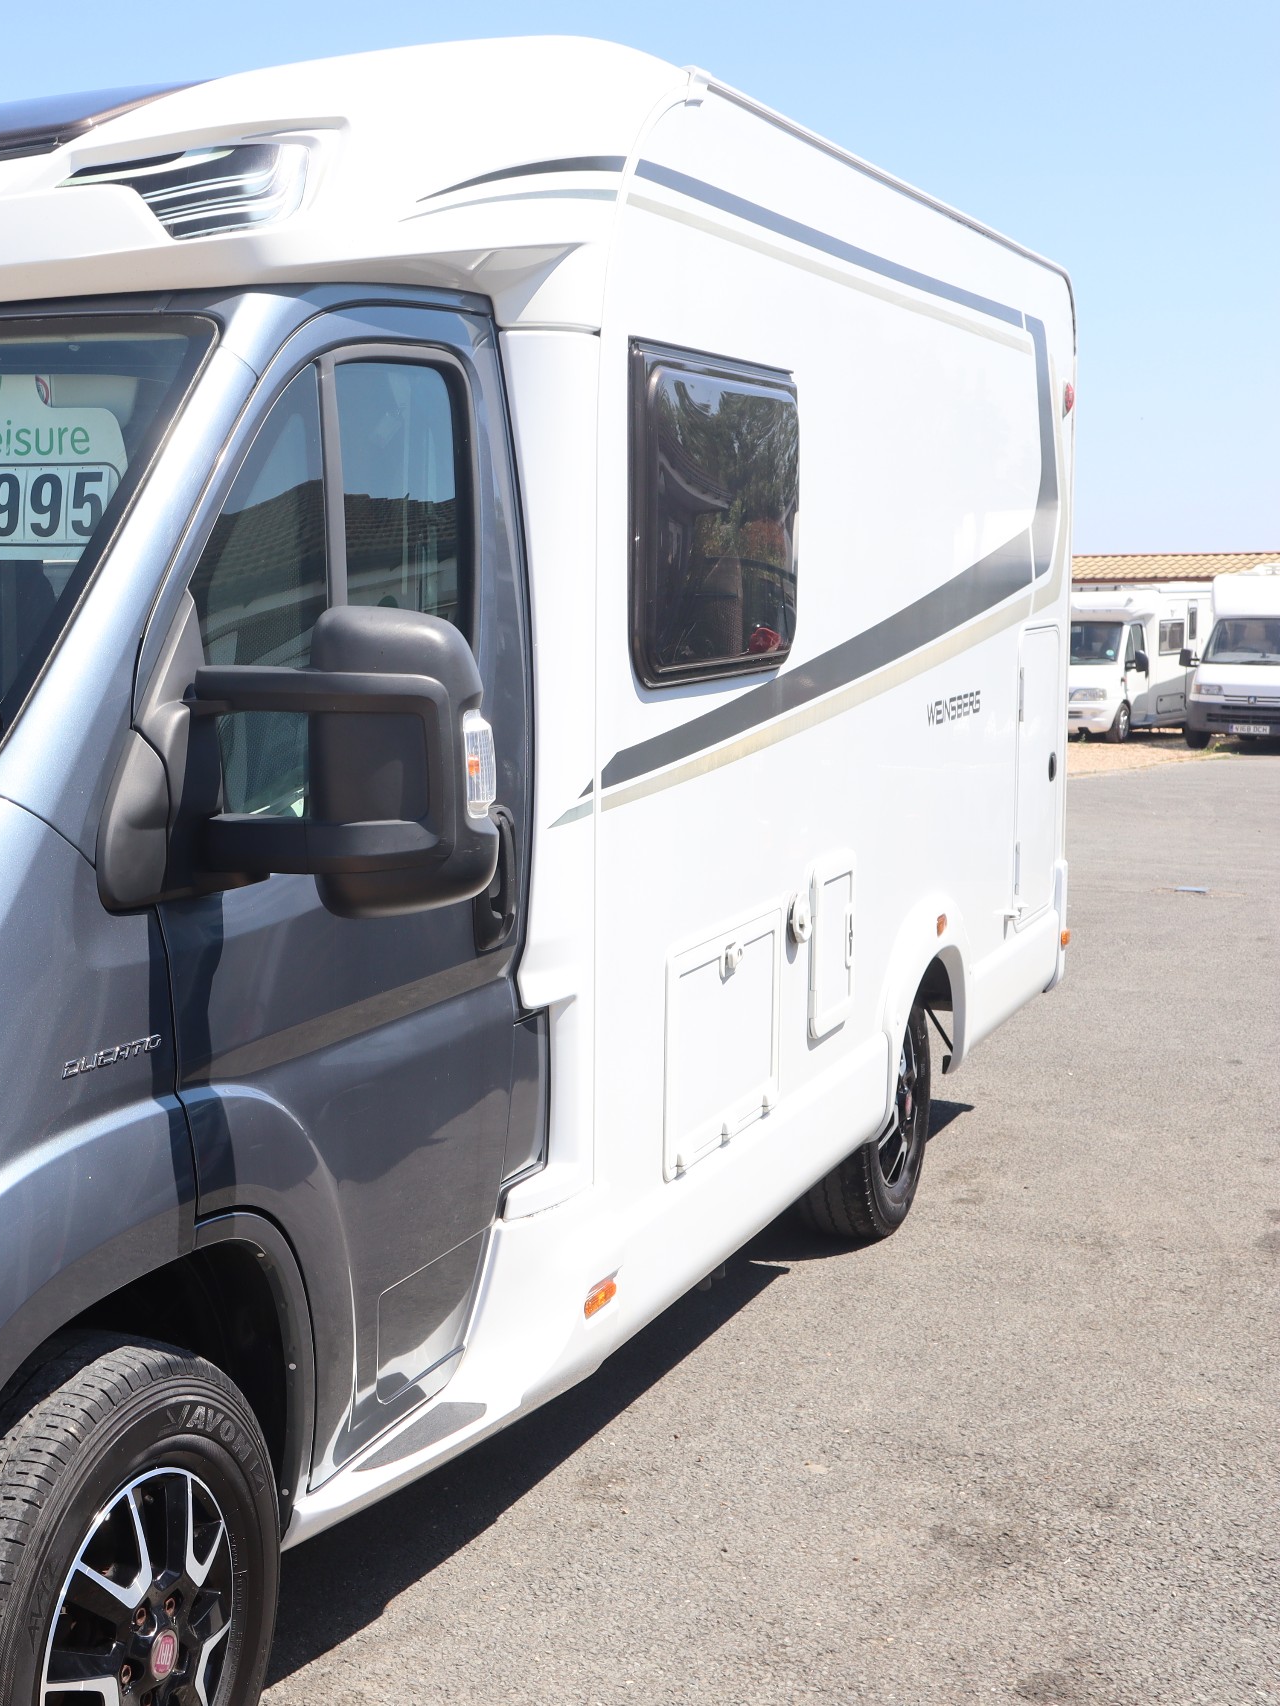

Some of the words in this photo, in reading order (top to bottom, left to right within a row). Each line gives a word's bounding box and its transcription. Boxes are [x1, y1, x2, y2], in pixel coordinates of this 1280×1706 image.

[926, 690, 981, 727] WEINSBERG
[62, 1033, 161, 1080] DUCATO
[185, 1405, 252, 1463] AVON
